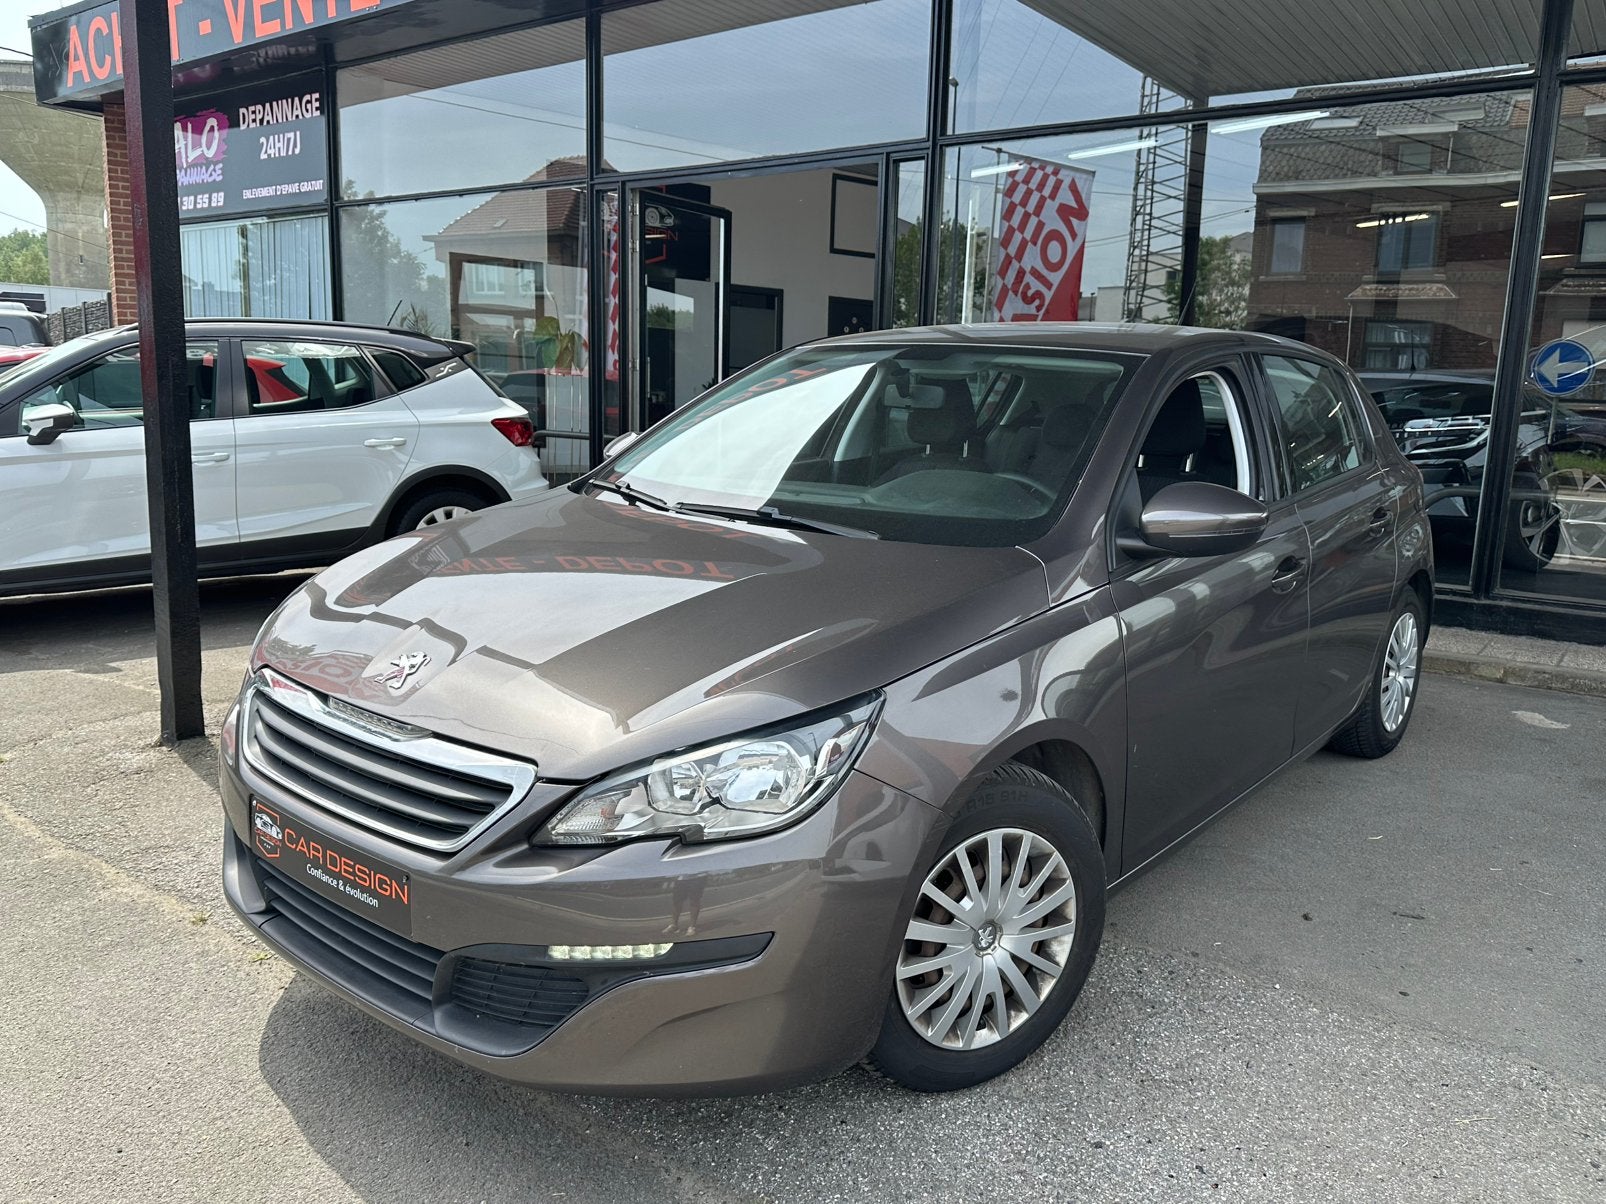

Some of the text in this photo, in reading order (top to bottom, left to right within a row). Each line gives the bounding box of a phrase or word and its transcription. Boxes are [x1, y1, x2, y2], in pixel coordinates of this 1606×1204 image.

[239, 93, 320, 130] DEPANNAGE
[259, 131, 301, 160] 24H/7J
[182, 197, 194, 211] 30
[197, 194, 209, 208] 55
[211, 192, 225, 206] 89
[242, 180, 324, 199] ENLEVEMENT D'EPAVE GRATUIT
[284, 828, 409, 905] CAR DESIGN
[306, 863, 379, 908] Confiance & évolution
